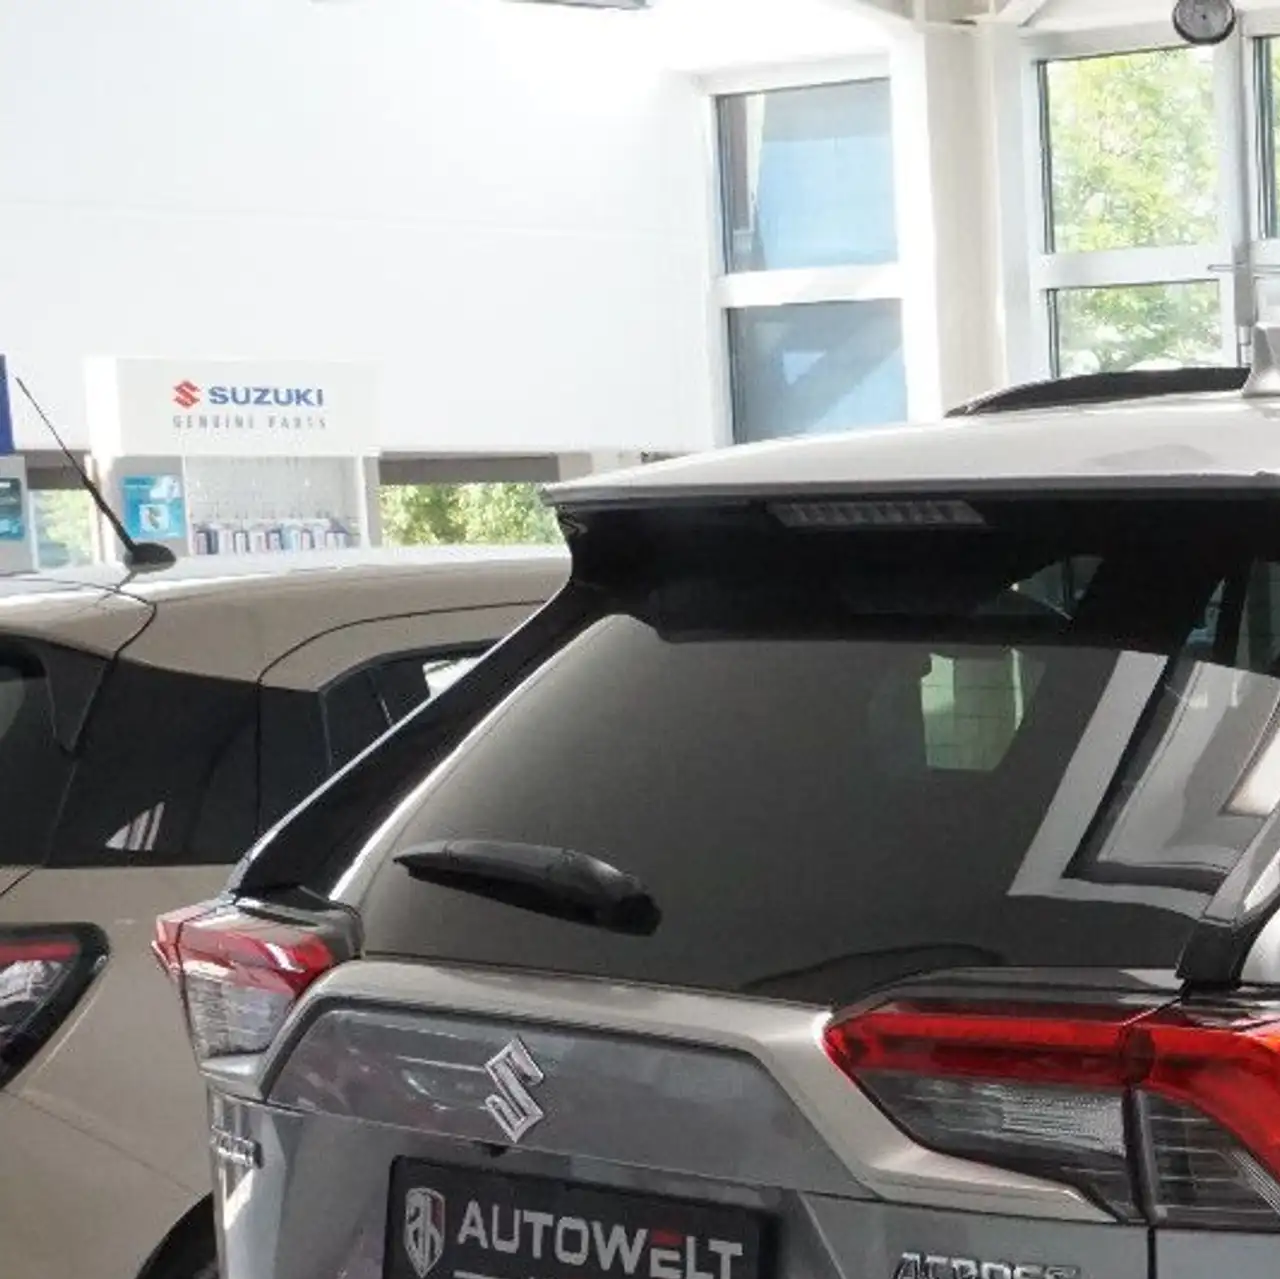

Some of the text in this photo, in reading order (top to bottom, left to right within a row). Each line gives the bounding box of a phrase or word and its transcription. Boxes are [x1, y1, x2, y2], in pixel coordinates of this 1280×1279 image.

[208, 386, 324, 407] SUZUKI
[172, 414, 327, 430] GENUINE PARTS
